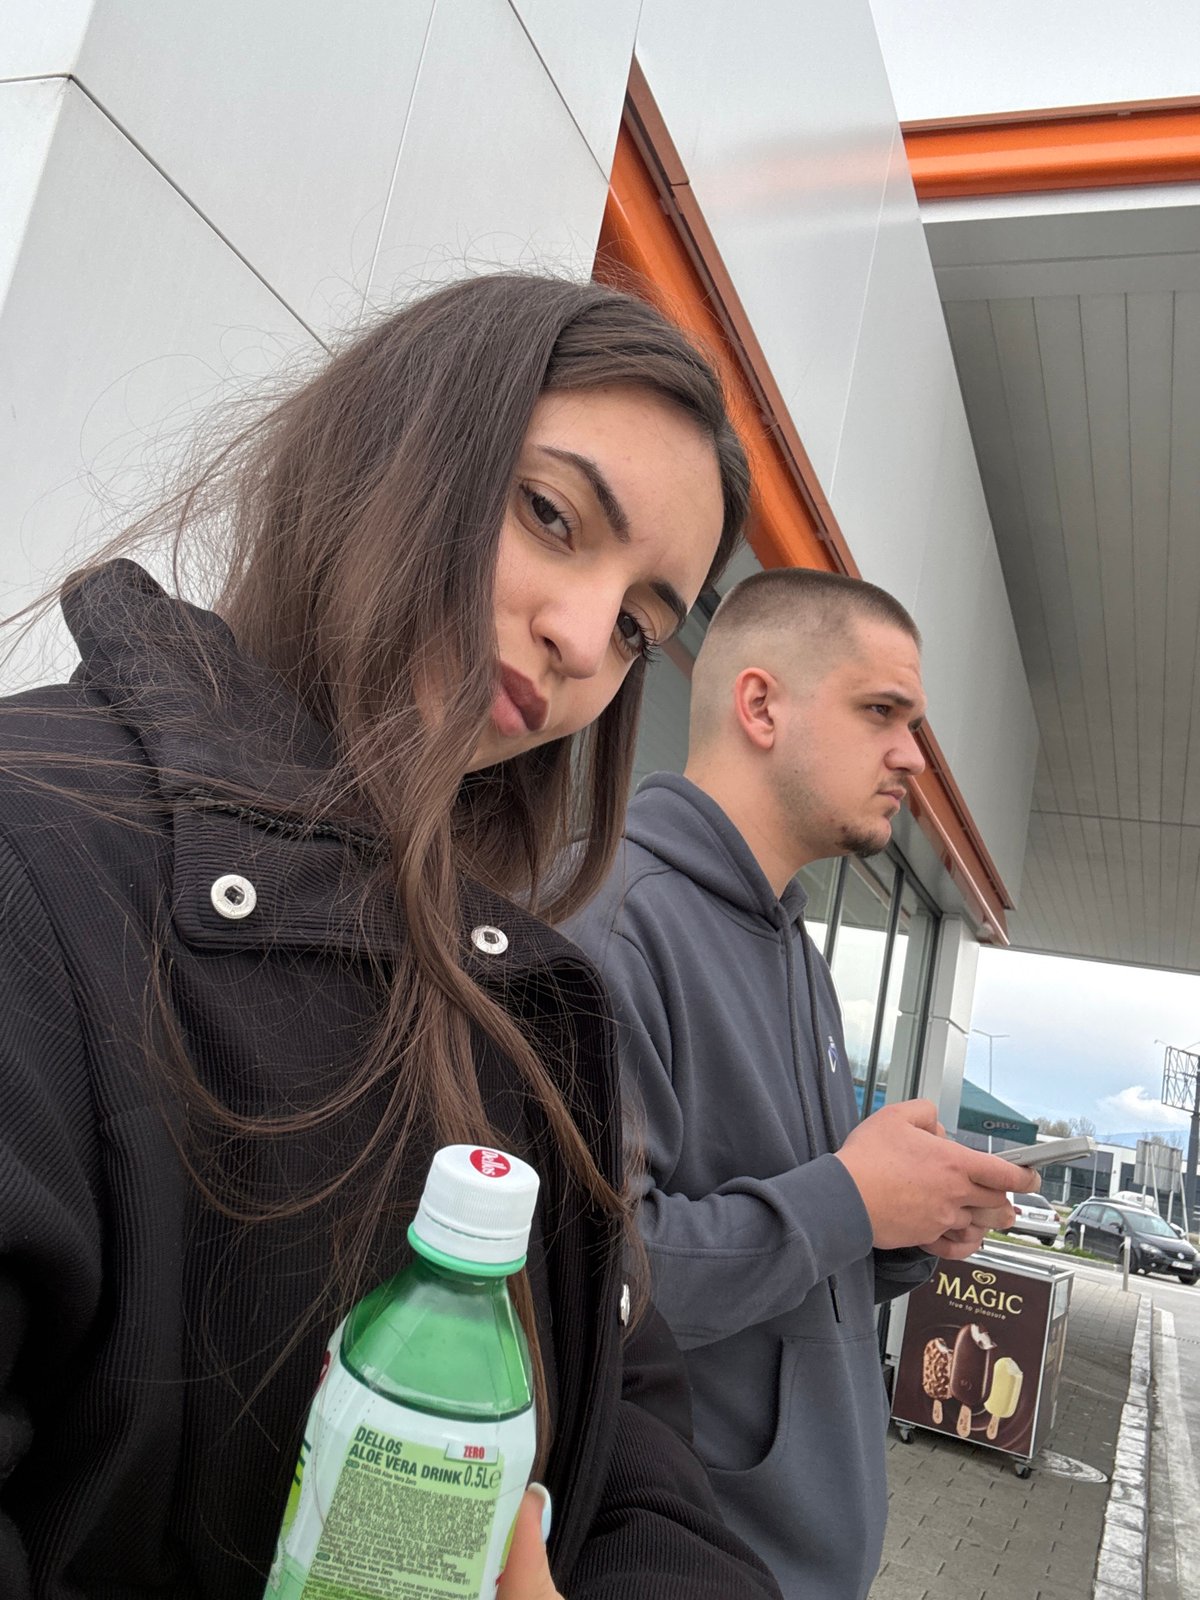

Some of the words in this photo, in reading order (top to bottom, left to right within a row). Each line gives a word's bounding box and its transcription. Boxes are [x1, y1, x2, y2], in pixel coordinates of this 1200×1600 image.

[936, 1271, 1024, 1315] MAGIC
[949, 1300, 963, 1309] true
[965, 1304, 973, 1312] to
[974, 1307, 1007, 1321] pleasure
[354, 1425, 403, 1456] DELLOS
[463, 1445, 485, 1460] ZERO
[348, 1443, 384, 1466] ALOE
[385, 1454, 417, 1477] VERA
[421, 1464, 463, 1485] DRINK
